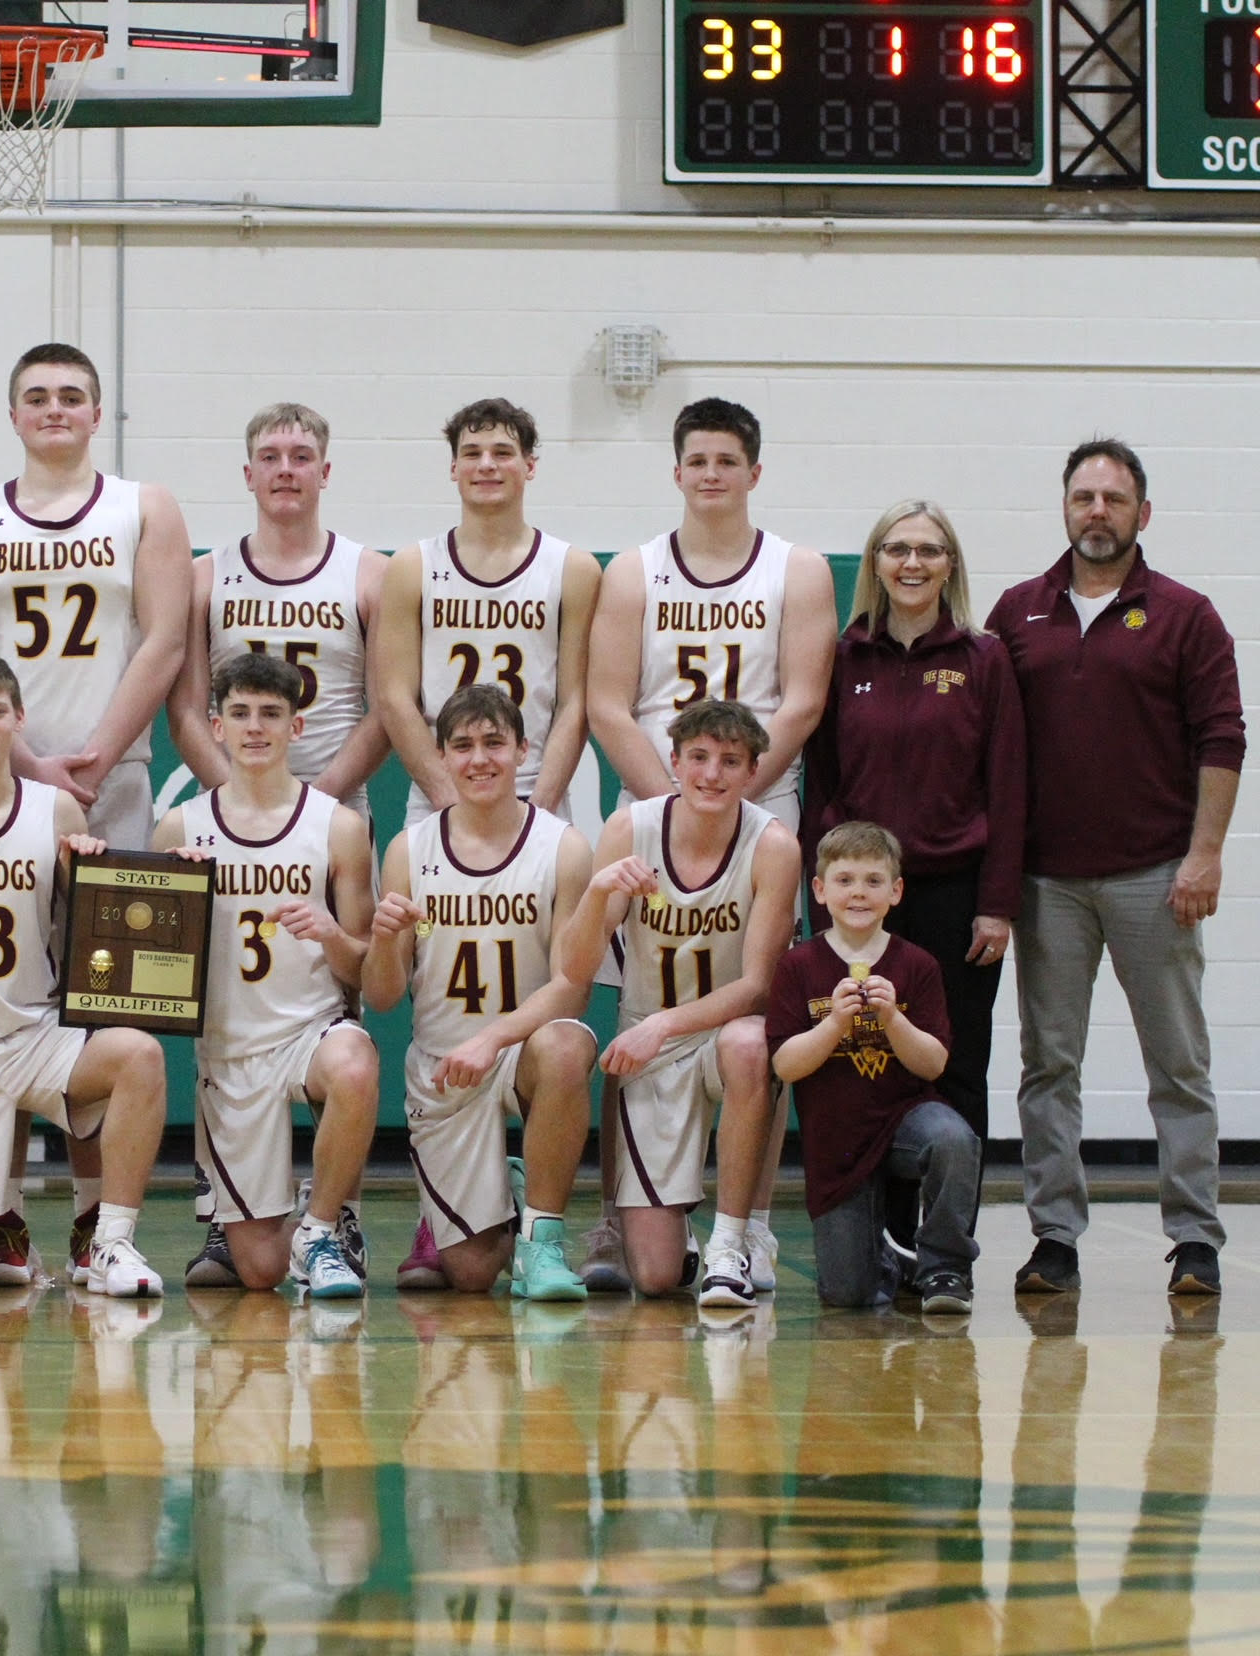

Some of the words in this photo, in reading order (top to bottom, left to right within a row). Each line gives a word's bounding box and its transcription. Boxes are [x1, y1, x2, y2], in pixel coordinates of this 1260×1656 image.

[703, 19, 782, 80] 33
[889, 26, 903, 77] 1
[962, 22, 1022, 83] 16
[12, 581, 101, 661] 52
[223, 599, 345, 631] BULLDOGS
[432, 598, 546, 631] BULLDOGS
[656, 600, 767, 632] BULLDOGS
[244, 639, 320, 711] 5
[447, 641, 526, 708] 23
[673, 642, 743, 712] 51
[115, 871, 171, 887] STATE
[214, 863, 312, 896] ULLDOGS
[101, 906, 120, 920] 20
[156, 911, 178, 926] 24
[425, 892, 538, 928] BULLDOGS
[639, 896, 741, 936] BULLDOGS
[237, 907, 274, 986] 3
[446, 938, 518, 1015] 41
[656, 944, 713, 1010] 11
[80, 995, 184, 1014] QUALIFIER
